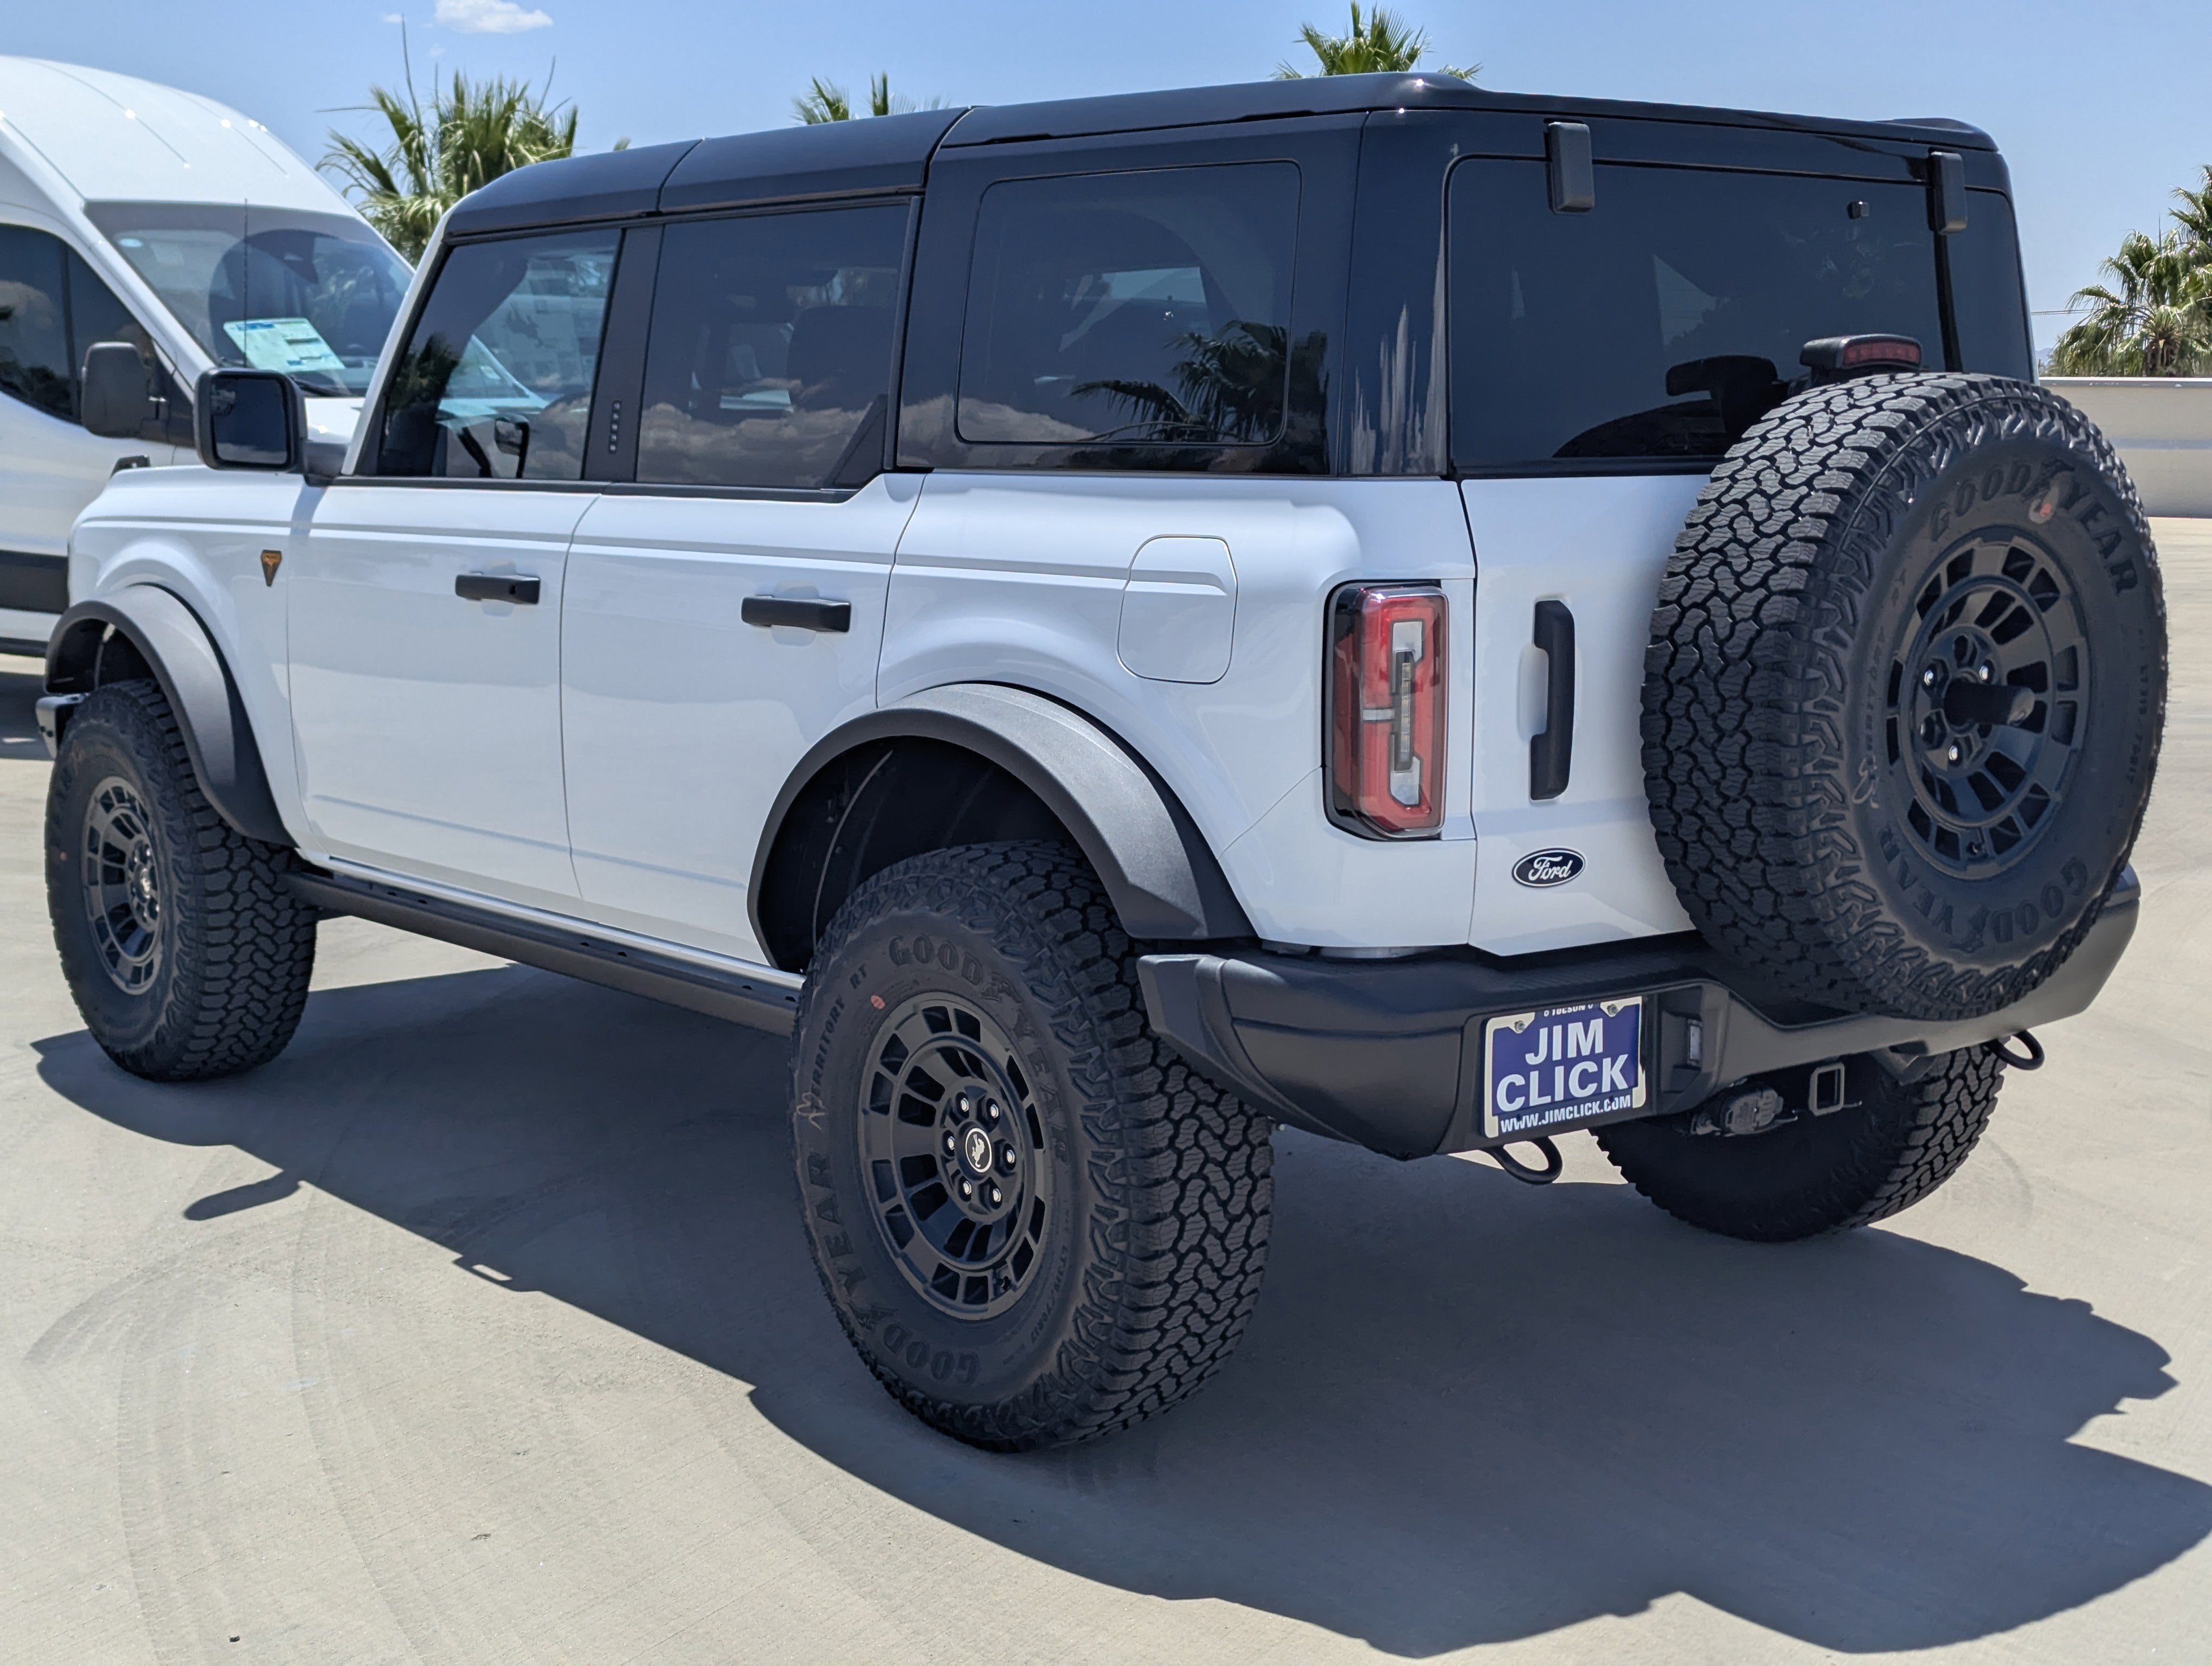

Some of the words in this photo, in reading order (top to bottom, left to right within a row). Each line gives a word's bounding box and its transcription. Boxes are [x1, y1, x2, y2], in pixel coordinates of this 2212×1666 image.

[1929, 457, 2138, 595] GOODYEAR
[1528, 856, 1572, 881] Ford
[1879, 823, 2088, 954] GOODYEAR
[889, 933, 1070, 1163] GOODYEAR
[1496, 1054, 1628, 1112] CLICK
[1525, 1018, 1603, 1065] JIM
[1501, 1094, 1631, 1132] WWW.JIMCLICK.COM
[807, 1152, 980, 1386] GOODYEAR
